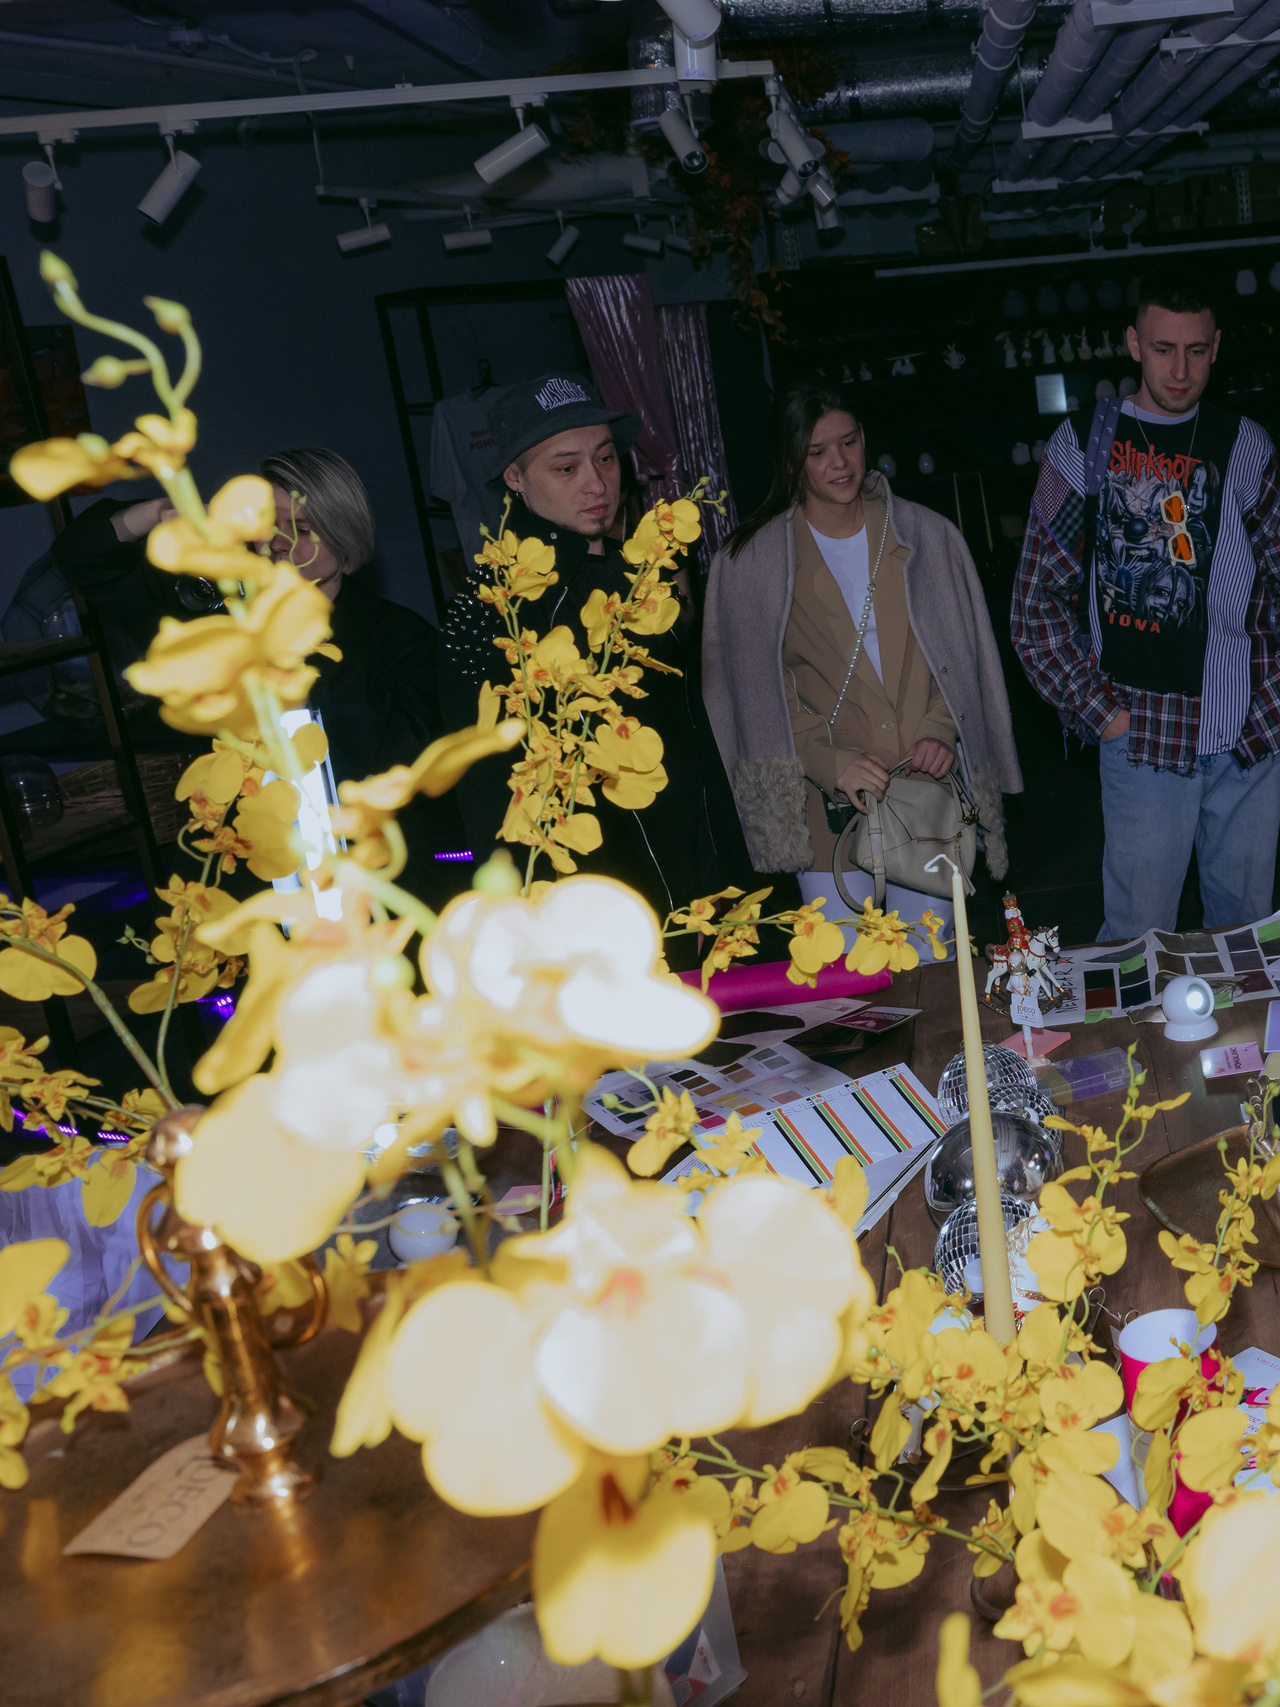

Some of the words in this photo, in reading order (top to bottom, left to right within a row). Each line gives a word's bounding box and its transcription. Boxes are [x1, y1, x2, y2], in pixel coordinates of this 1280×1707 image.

[1108, 612, 1161, 634] IOWA
[781, 1093, 835, 1117] SUEDE
[838, 1068, 906, 1097] LEATHER
[126, 1462, 218, 1549] DECO
